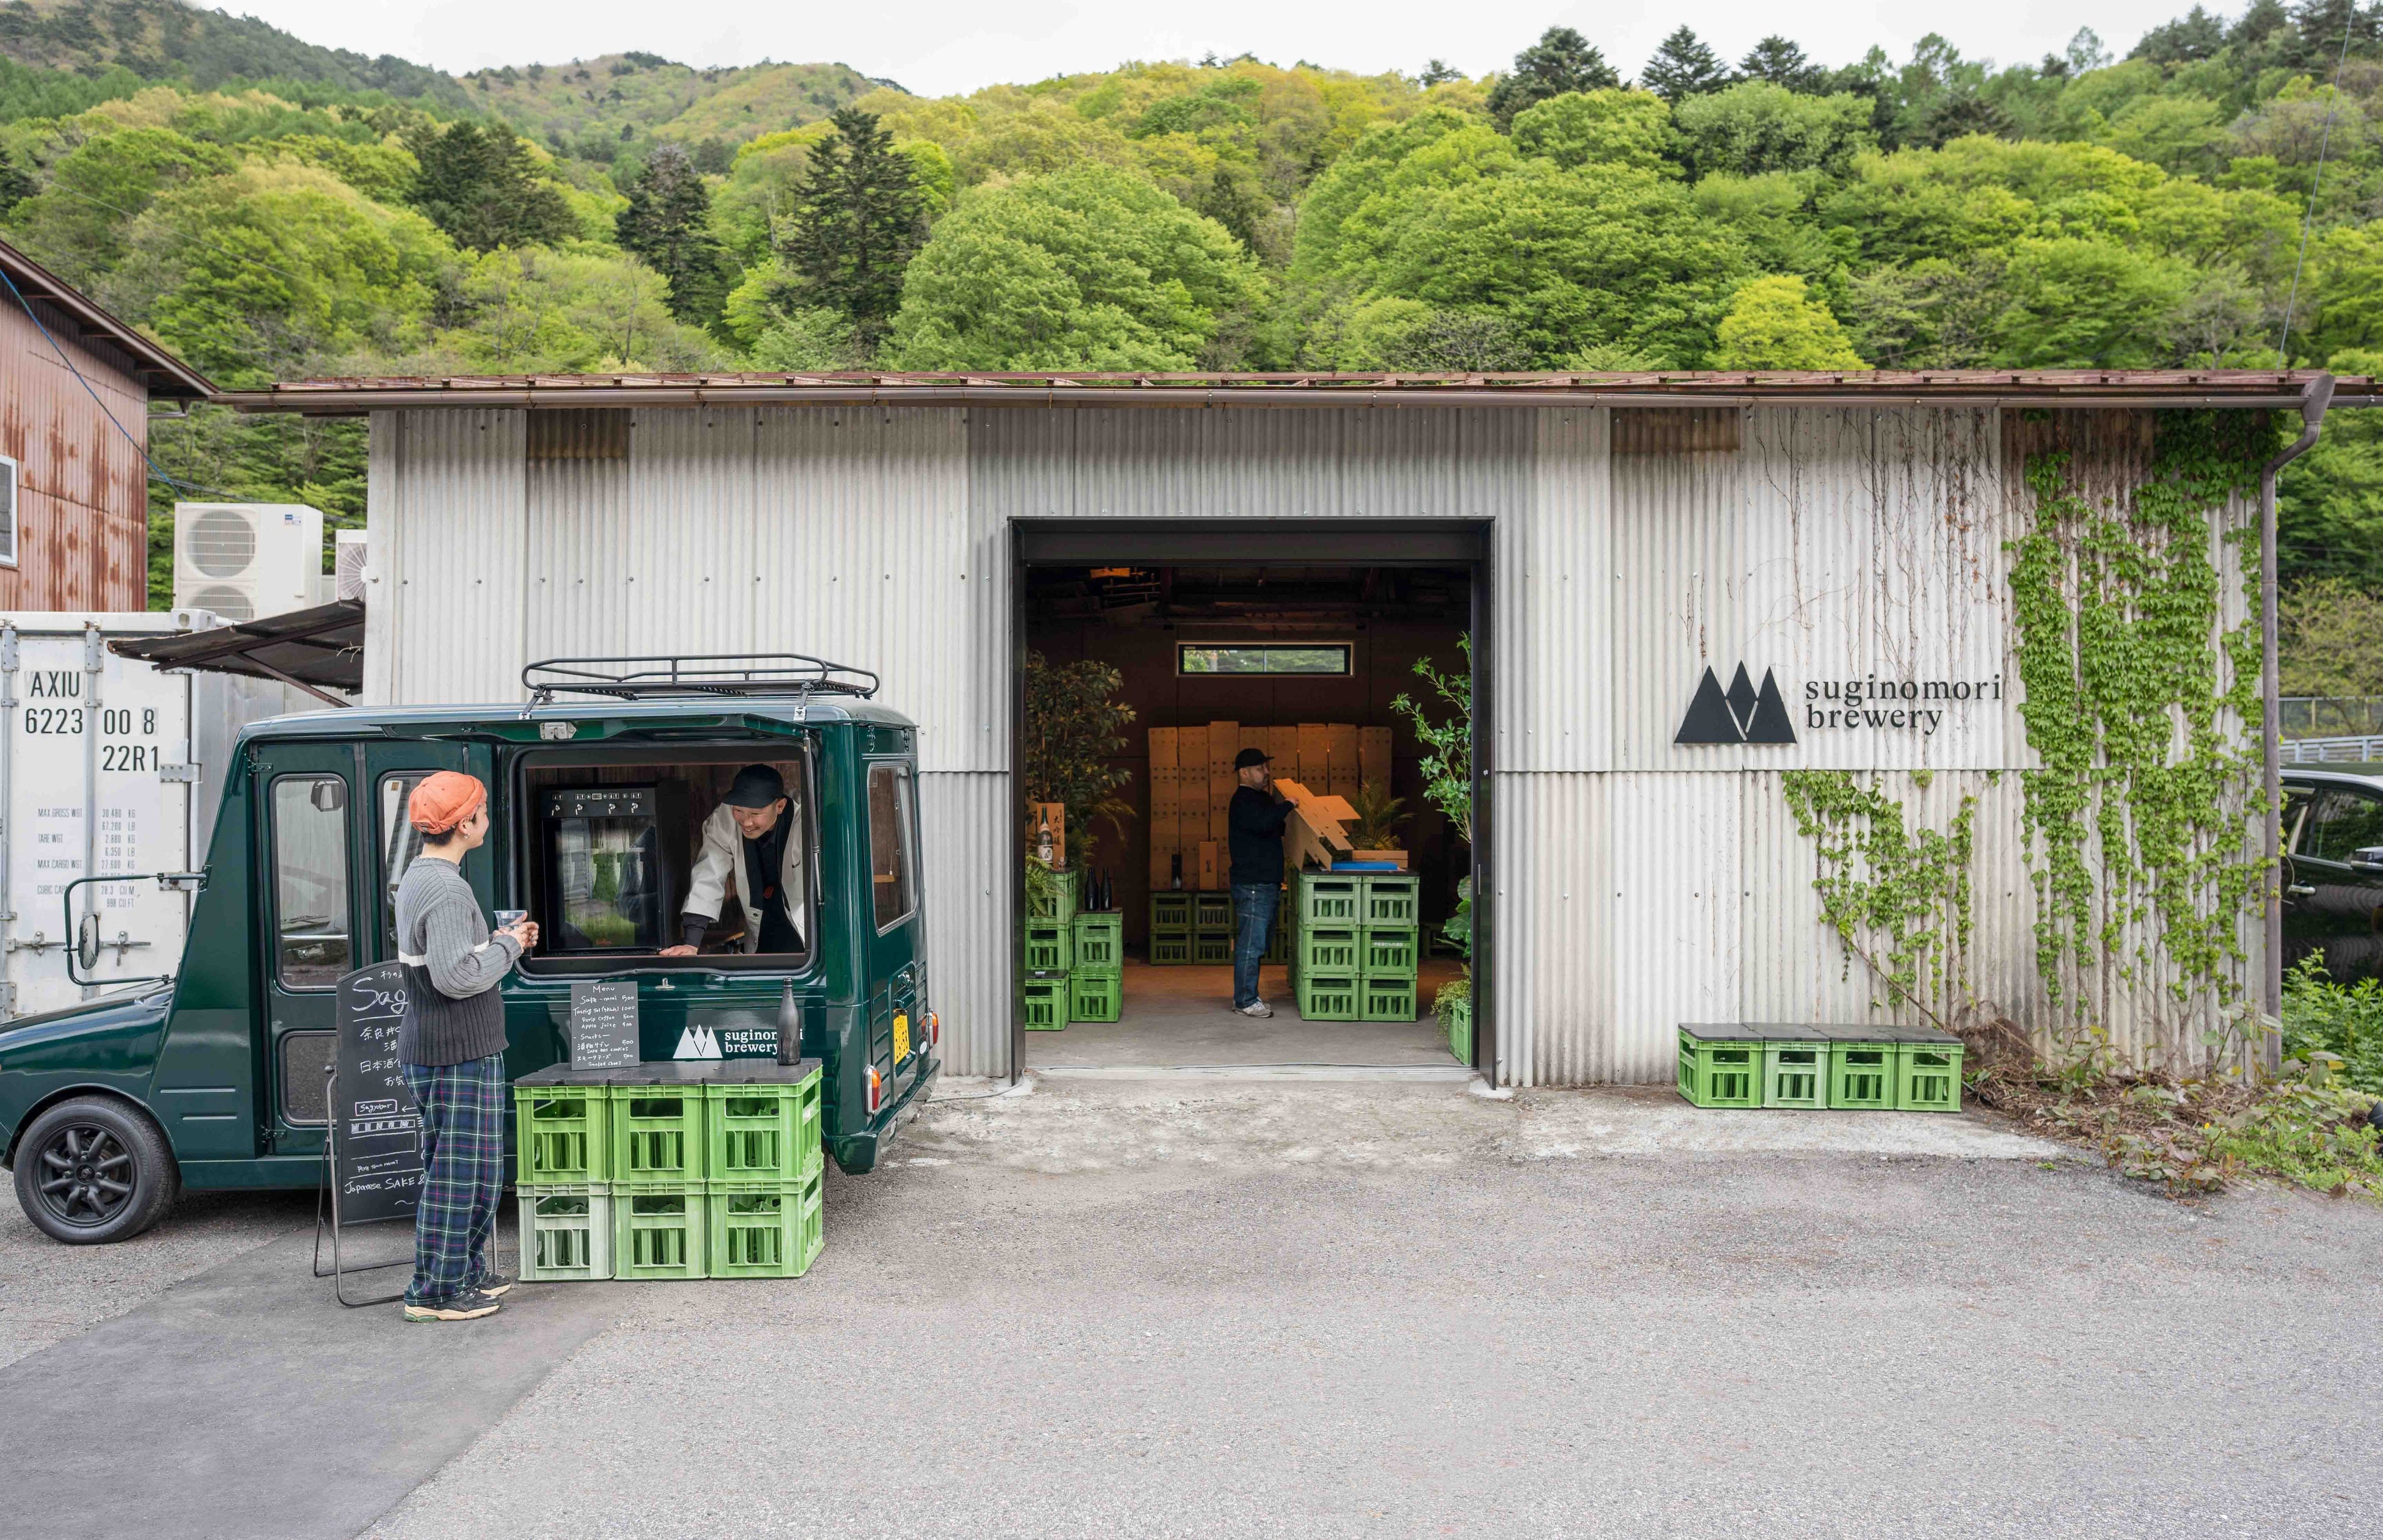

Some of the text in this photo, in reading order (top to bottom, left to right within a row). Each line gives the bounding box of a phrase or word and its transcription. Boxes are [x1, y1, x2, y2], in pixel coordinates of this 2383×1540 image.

[31, 671, 79, 697] AXIU
[1806, 674, 2002, 706] suginomori
[26, 709, 155, 734] 6223 00 8
[1807, 704, 1943, 735] brewery
[103, 745, 159, 771] 22R1
[38, 808, 83, 817] MAX GROSS WGT
[128, 809, 136, 818] KG
[128, 822, 135, 831] LB
[38, 834, 64, 843] TARE WGT
[128, 834, 135, 844] KG
[127, 847, 135, 856] LB
[37, 859, 82, 869] MAX CARGO WGT
[127, 860, 135, 869] KG
[37, 885, 53, 895] CUBIC
[593, 985, 615, 993] Menu
[580, 995, 597, 1005] Sake
[384, 1039, 397, 1052] 酒
[345, 1180, 382, 1194] Japanese
[384, 1177, 415, 1190] SAKE
